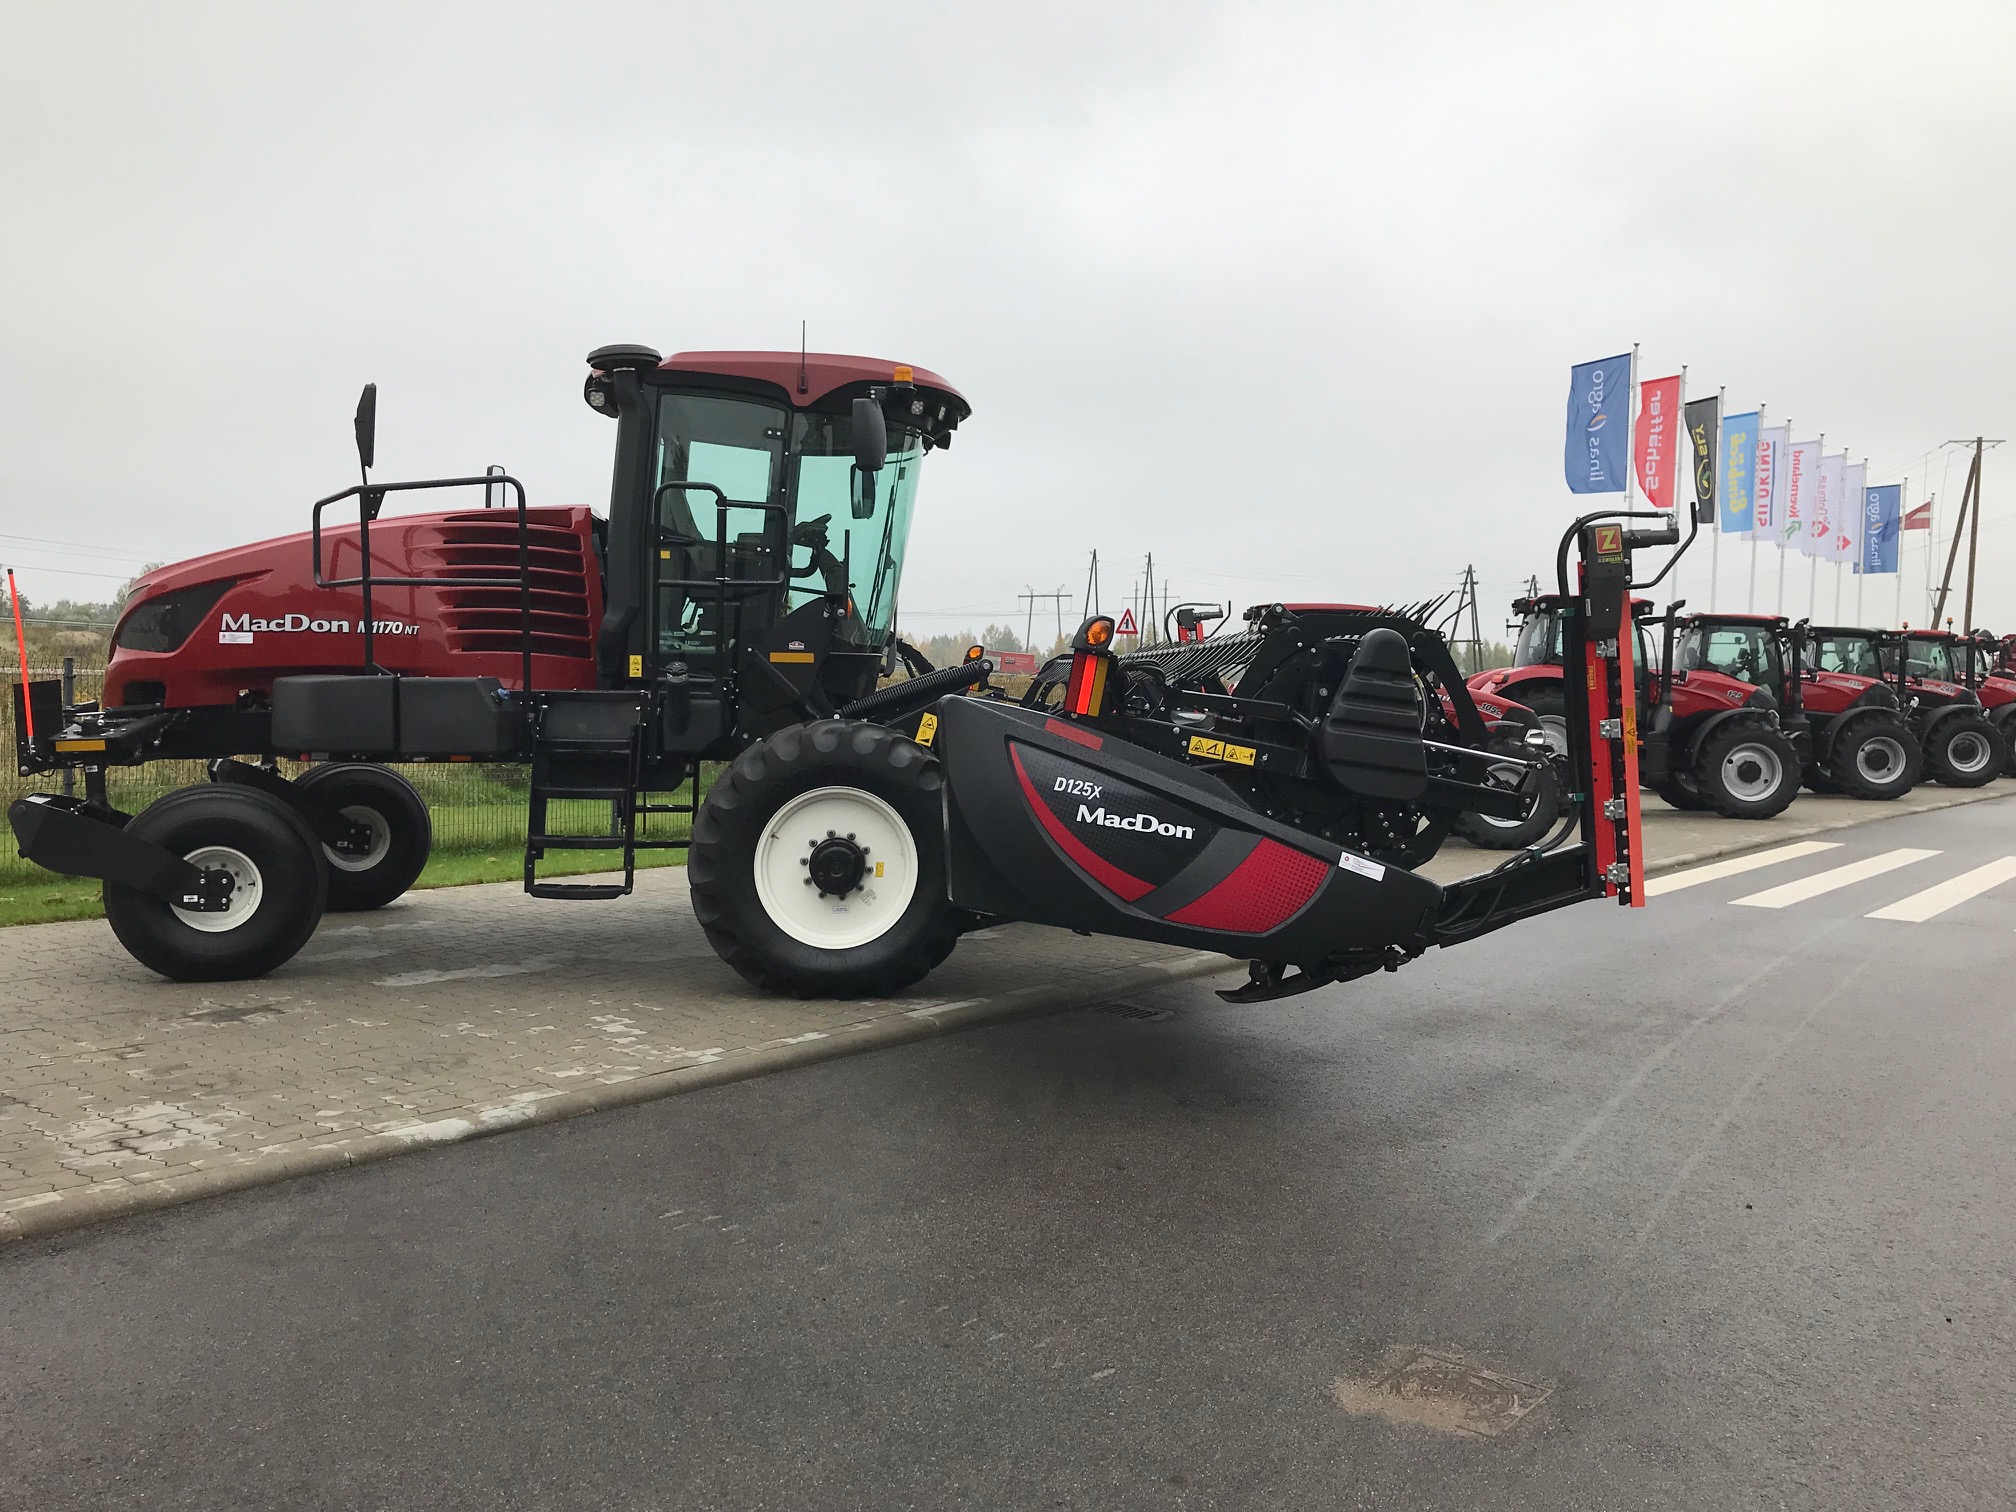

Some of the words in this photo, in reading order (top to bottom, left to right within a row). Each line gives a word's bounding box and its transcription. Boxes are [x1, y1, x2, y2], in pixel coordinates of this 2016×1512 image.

[1601, 530, 1617, 550] Z
[221, 613, 350, 633] MacDon
[404, 625, 420, 635] NT
[1053, 777, 1103, 800] D125X
[1076, 804, 1195, 840] MacDon
